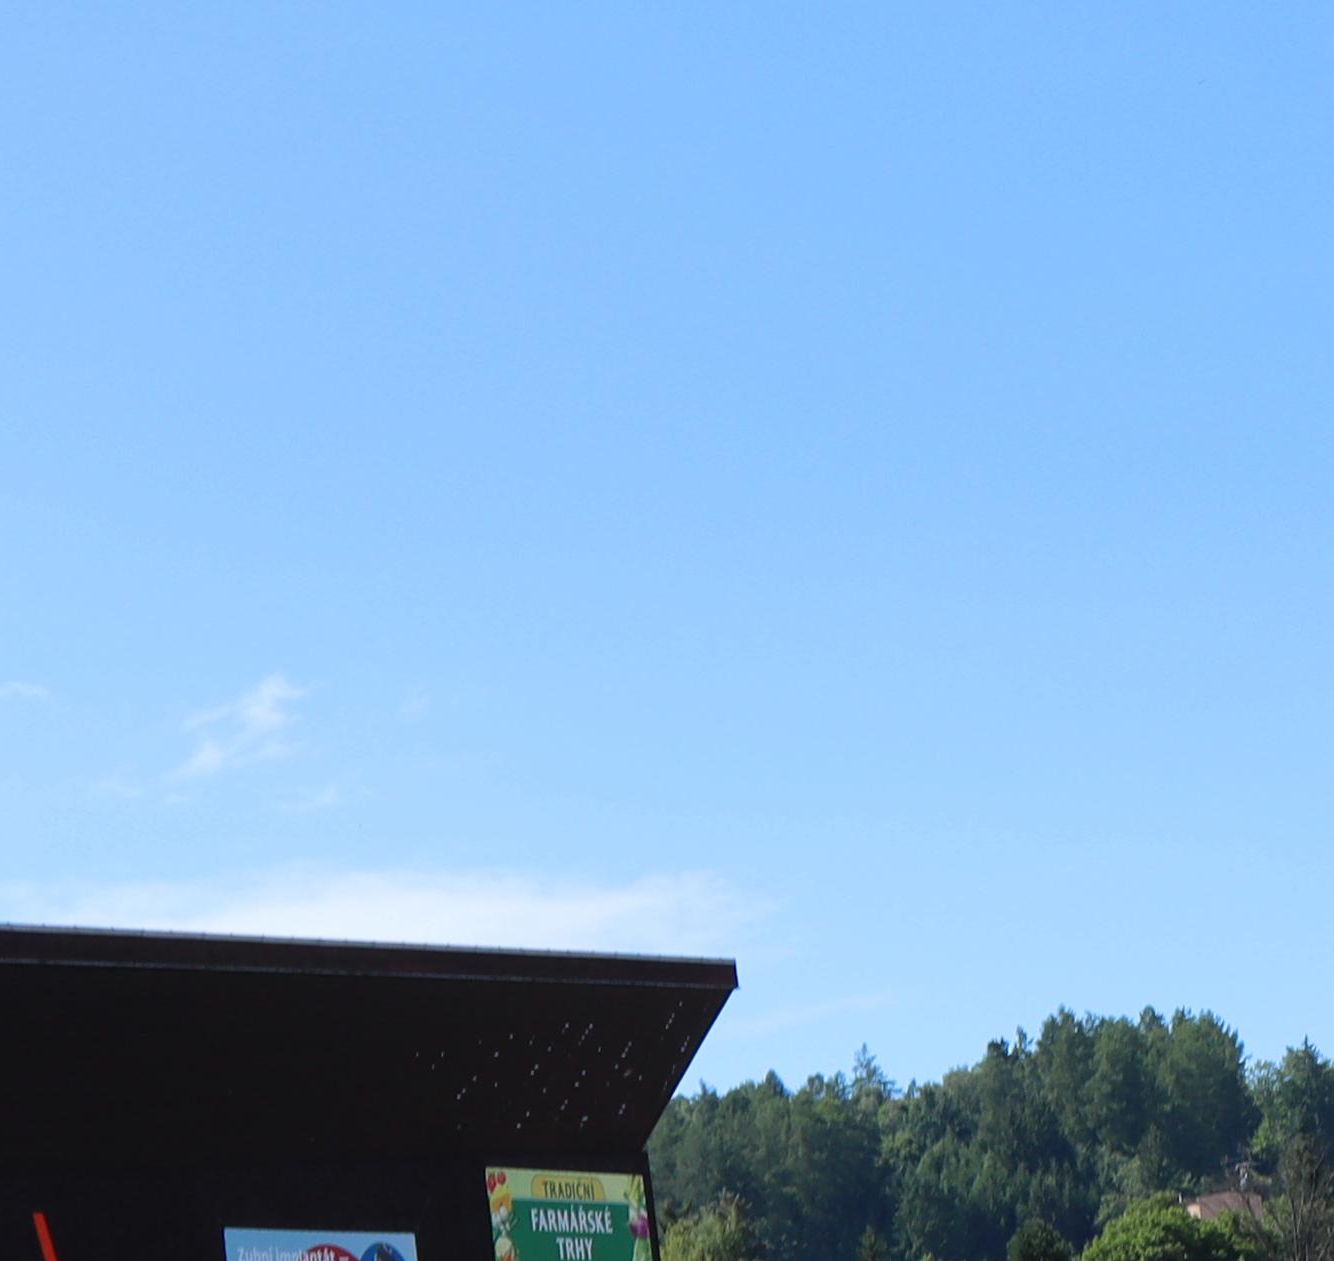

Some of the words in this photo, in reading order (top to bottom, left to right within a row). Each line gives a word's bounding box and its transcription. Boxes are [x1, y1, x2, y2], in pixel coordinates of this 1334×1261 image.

[542, 1178, 595, 1201] TRADIČNÍ
[530, 1204, 613, 1235] FARMÁŘSKÉ
[555, 1236, 593, 1261] TRHY
